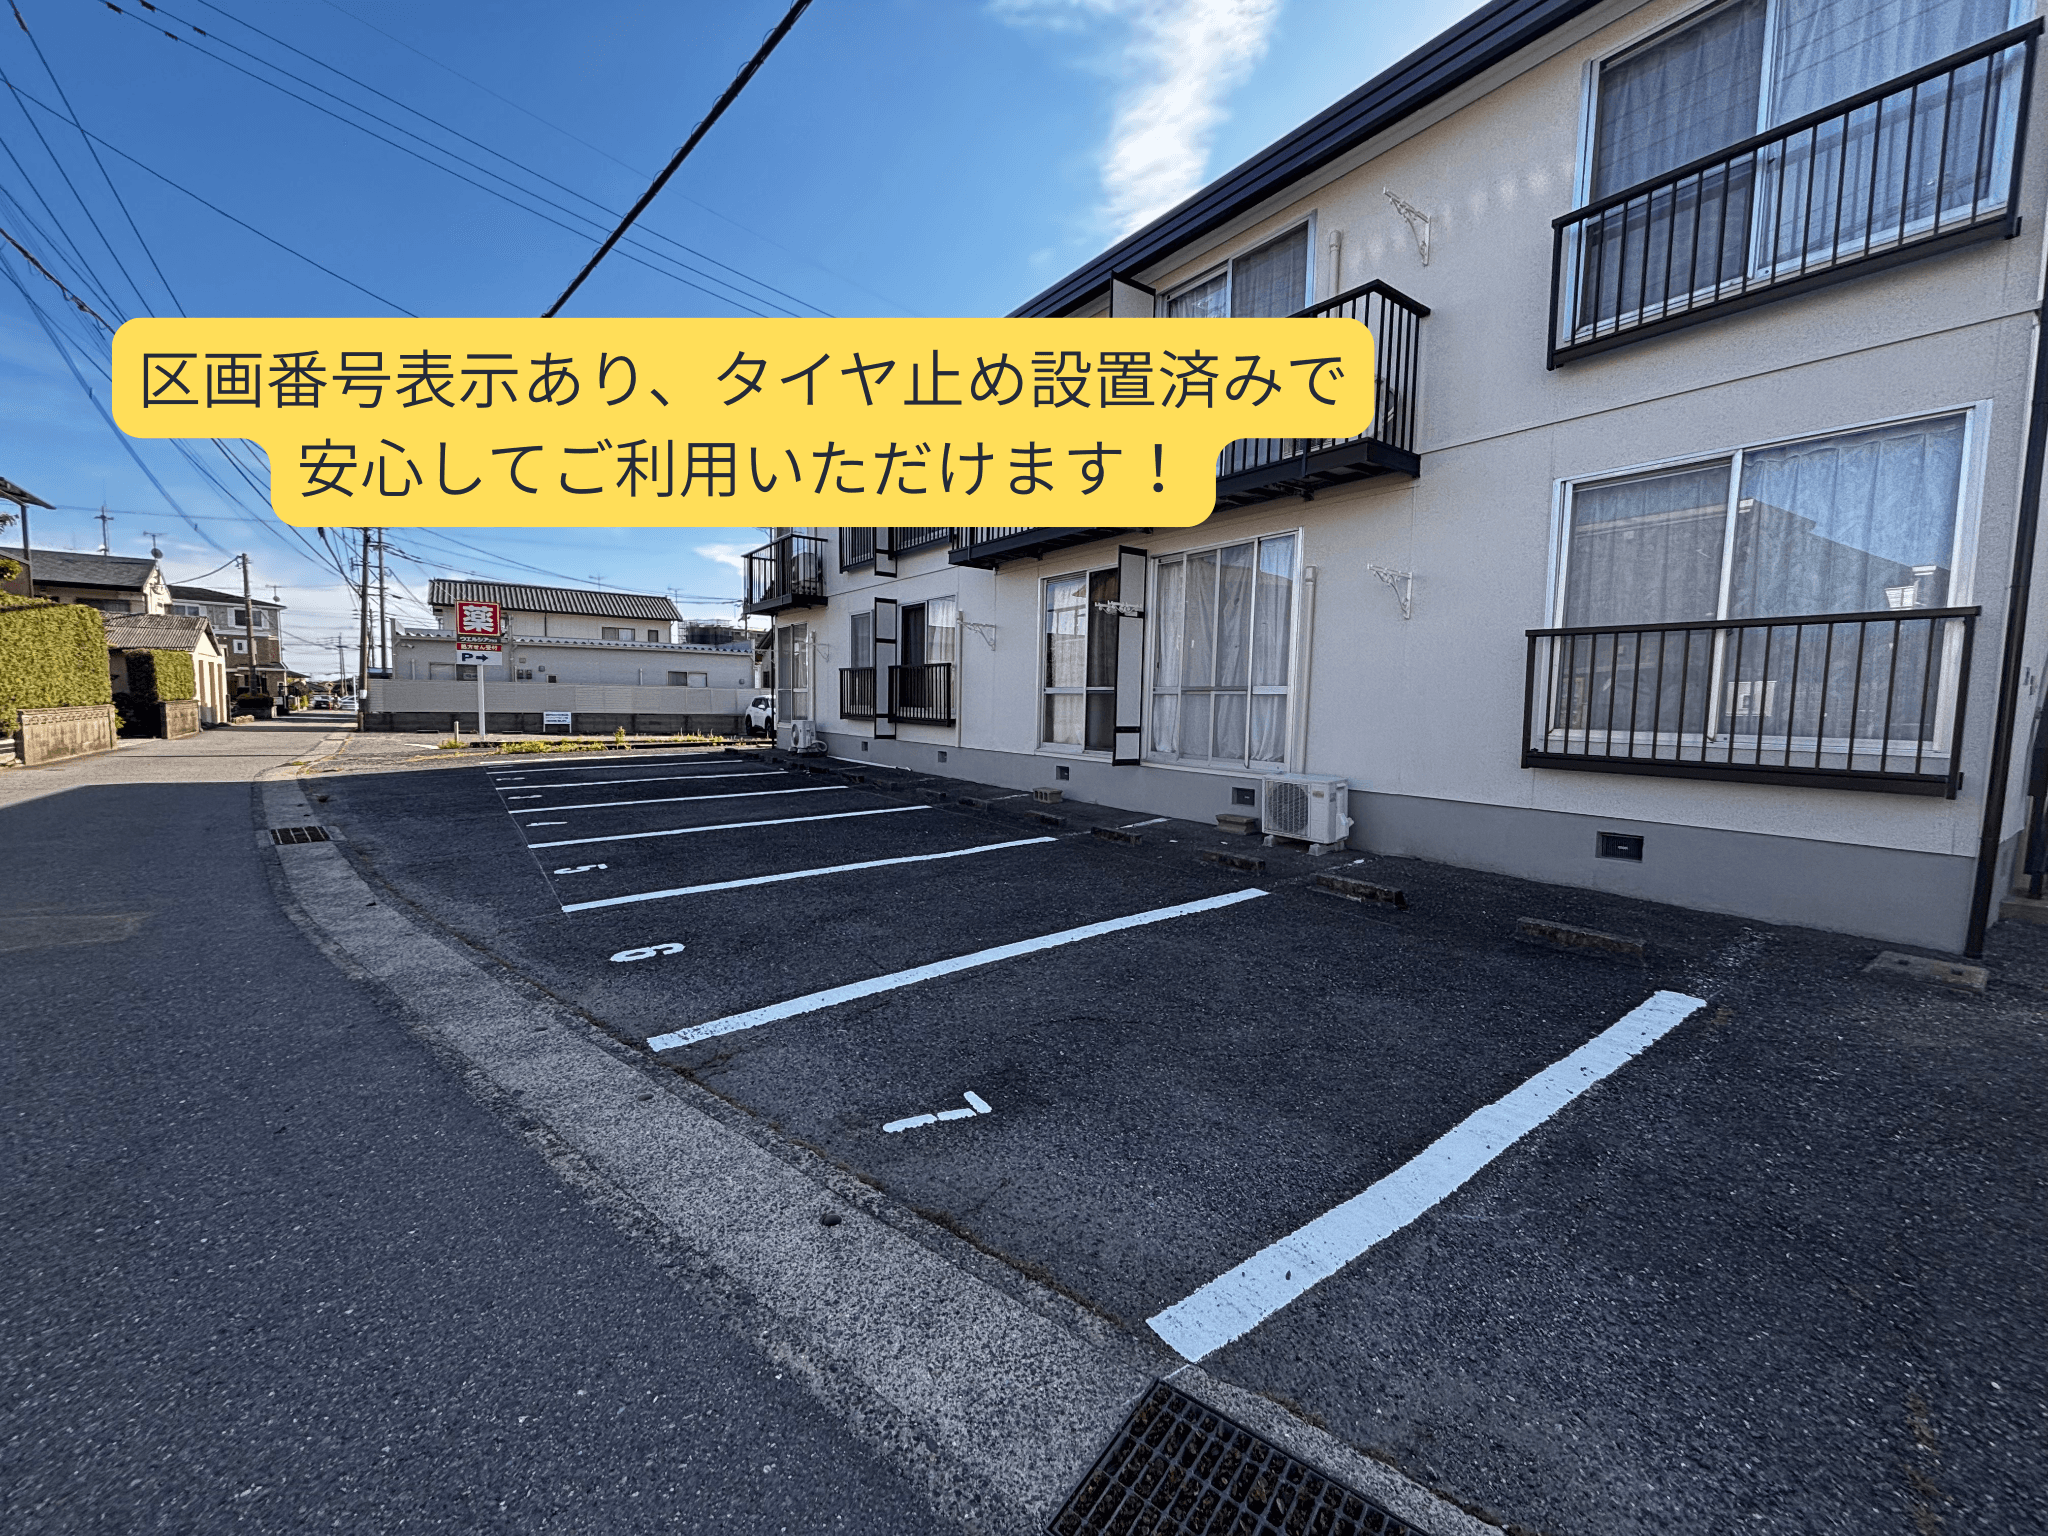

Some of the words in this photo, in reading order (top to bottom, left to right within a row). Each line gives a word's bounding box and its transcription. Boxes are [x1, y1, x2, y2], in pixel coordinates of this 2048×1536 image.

[462, 605, 494, 632] 薬
[461, 652, 474, 662] P
[609, 942, 686, 963] 6
